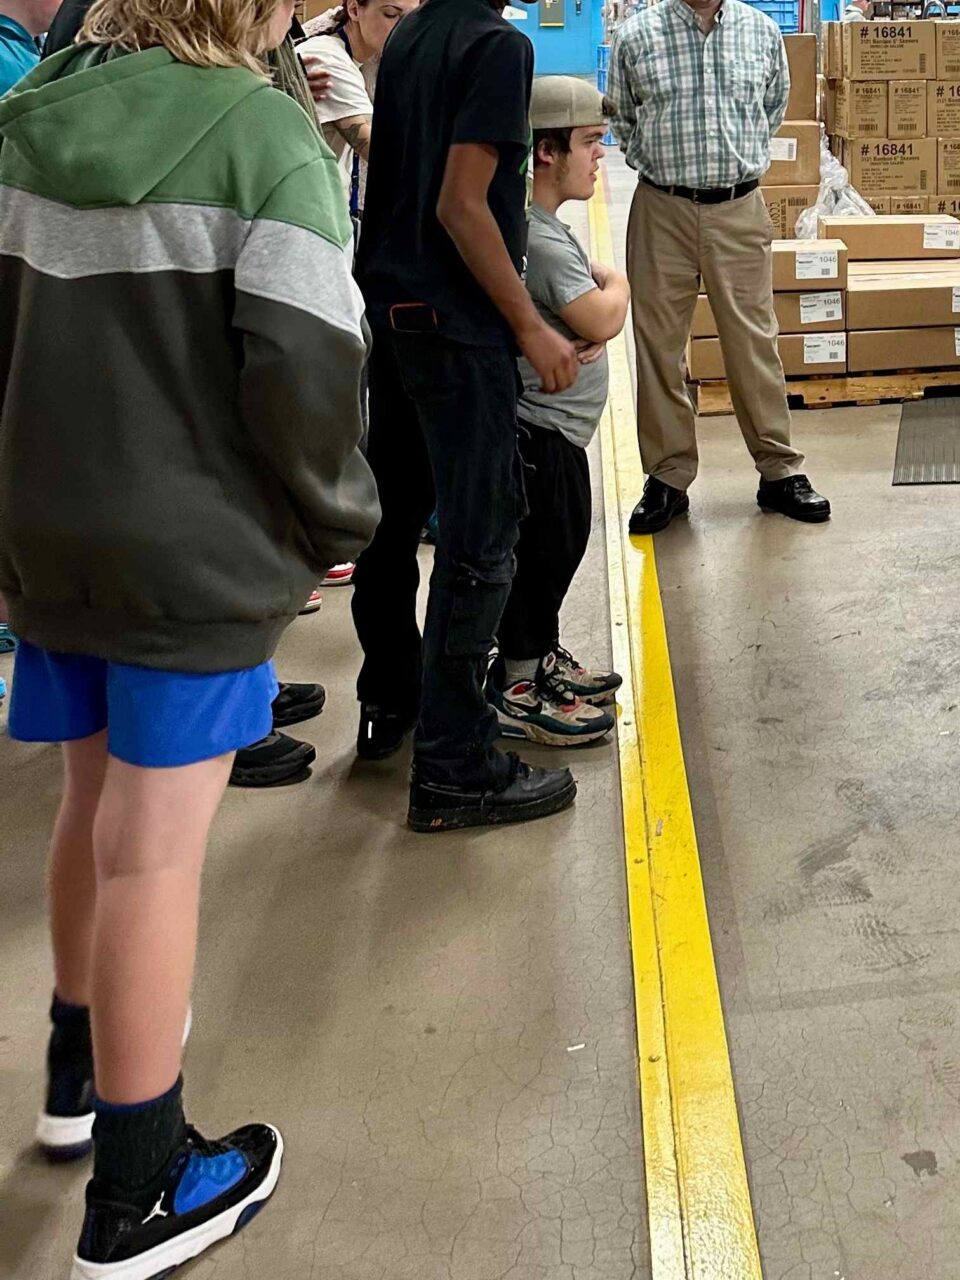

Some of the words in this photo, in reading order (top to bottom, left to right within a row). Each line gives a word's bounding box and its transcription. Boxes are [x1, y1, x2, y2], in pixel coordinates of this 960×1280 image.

[860, 26, 869, 38] #
[873, 26, 912, 38] 16841
[936, 86, 944, 97] #
[861, 144, 869, 156] #
[874, 143, 913, 155] 16841
[938, 201, 946, 213] #
